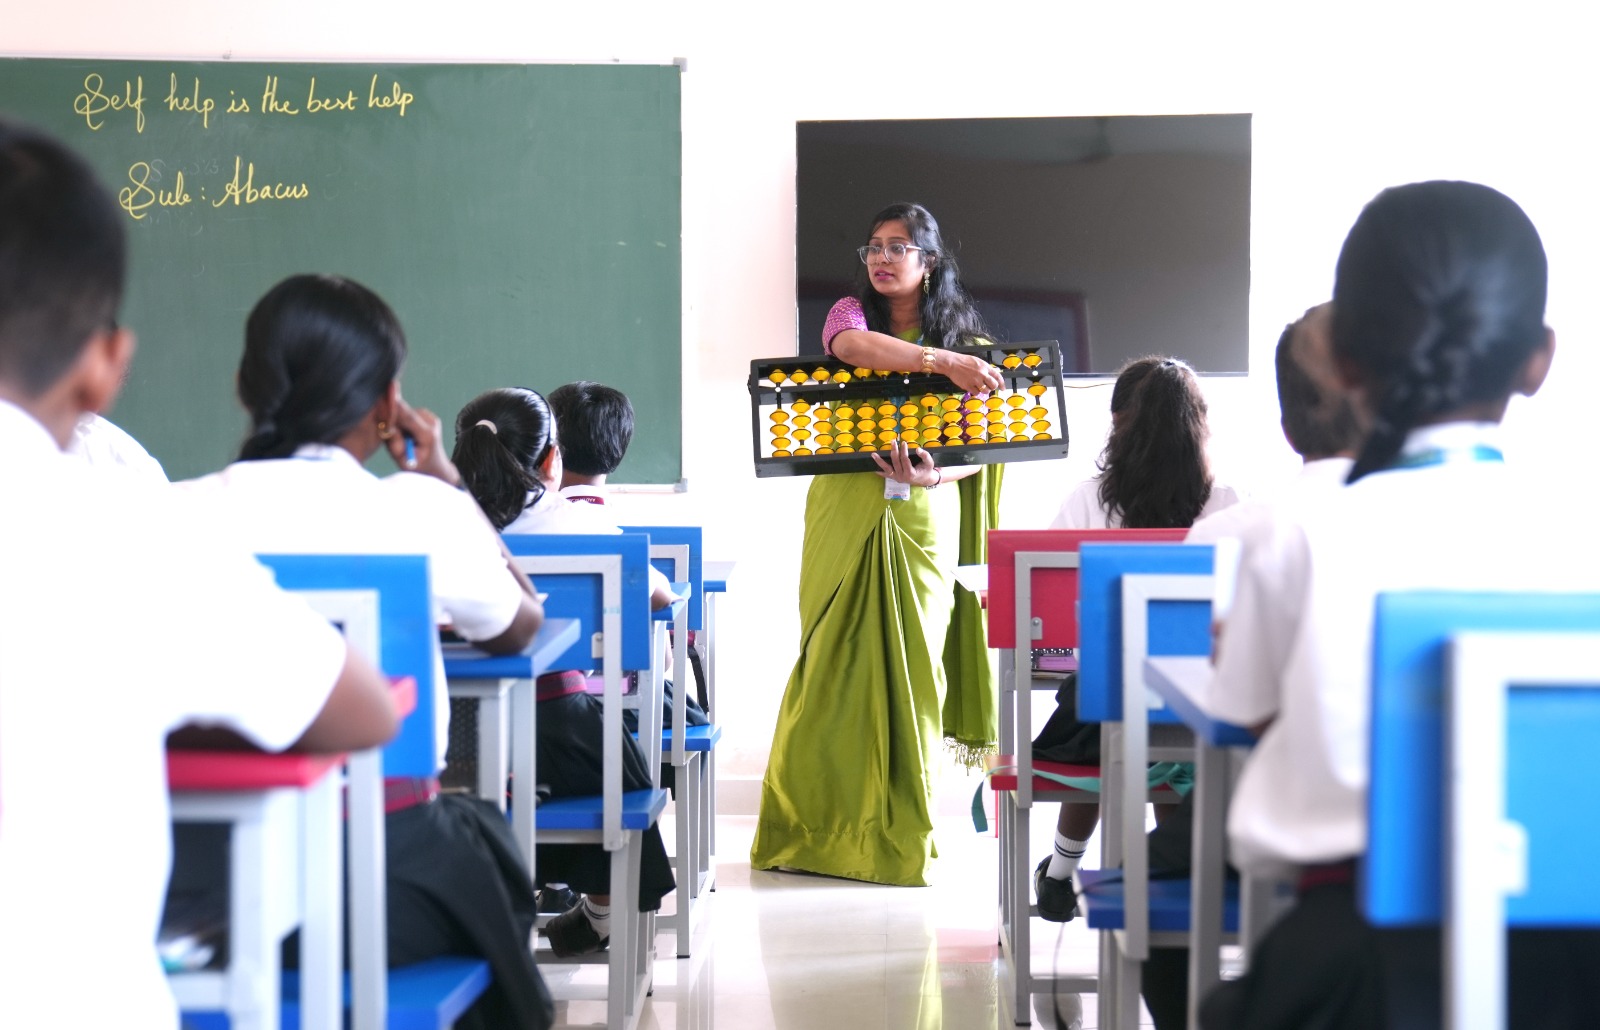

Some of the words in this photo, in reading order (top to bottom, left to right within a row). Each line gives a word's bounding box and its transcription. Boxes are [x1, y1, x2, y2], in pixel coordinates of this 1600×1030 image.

[74, 73, 147, 133] Self
[164, 73, 215, 128] help
[227, 90, 250, 113] is
[262, 76, 299, 114] the
[307, 77, 358, 112] best
[368, 74, 414, 116] help
[212, 156, 308, 207] Abacus
